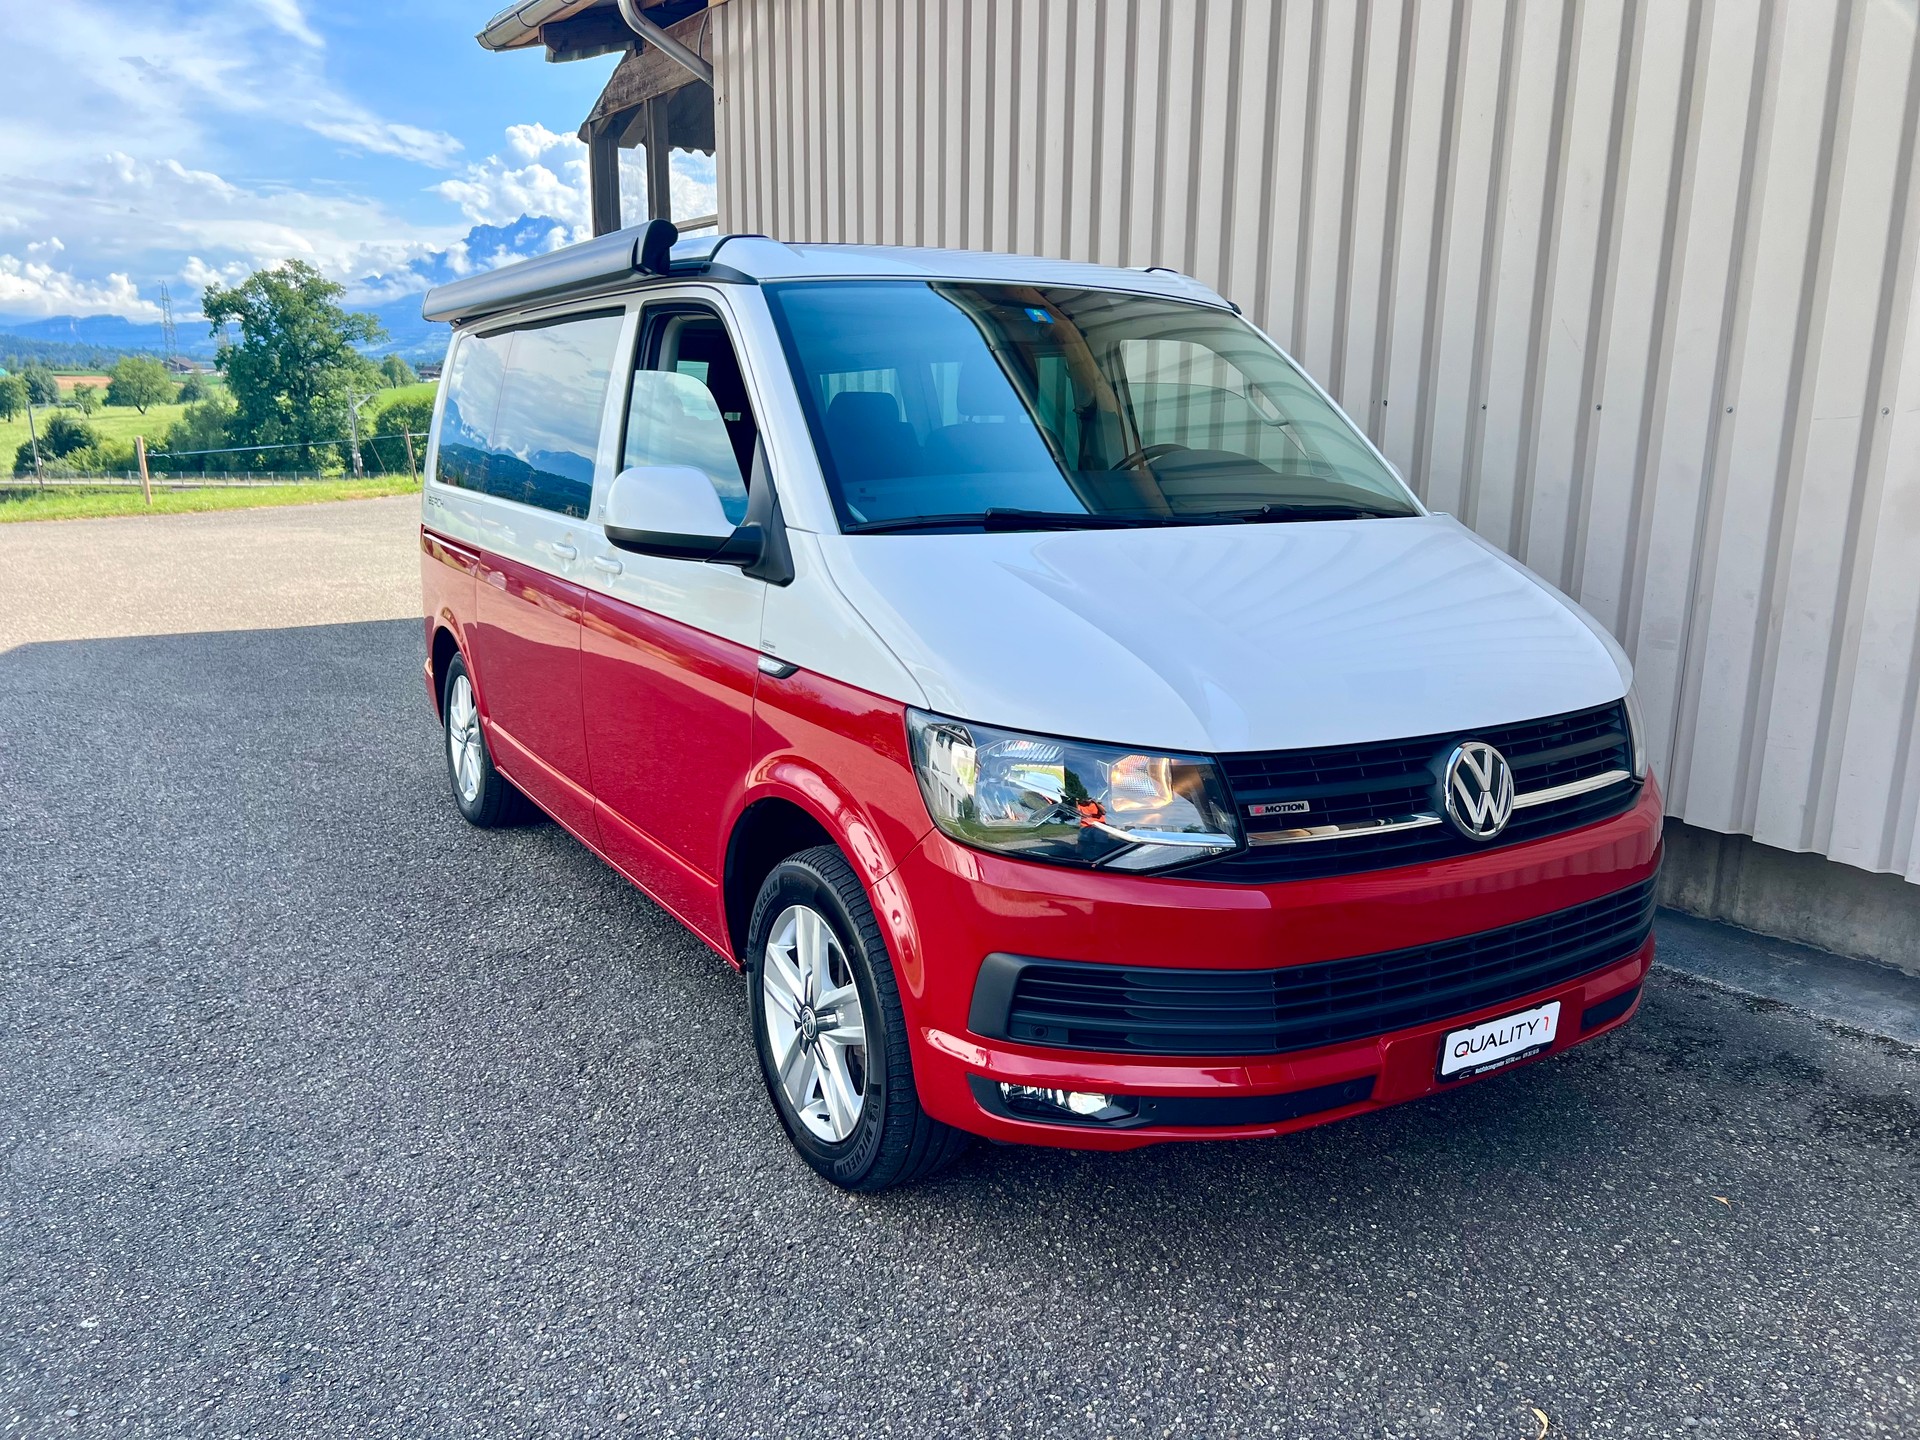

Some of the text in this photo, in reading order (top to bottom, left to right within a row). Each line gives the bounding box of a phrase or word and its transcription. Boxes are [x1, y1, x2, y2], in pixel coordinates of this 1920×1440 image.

[1454, 1016, 1549, 1058] QUALITY 1
[836, 1124, 874, 1177] MICHELIN
